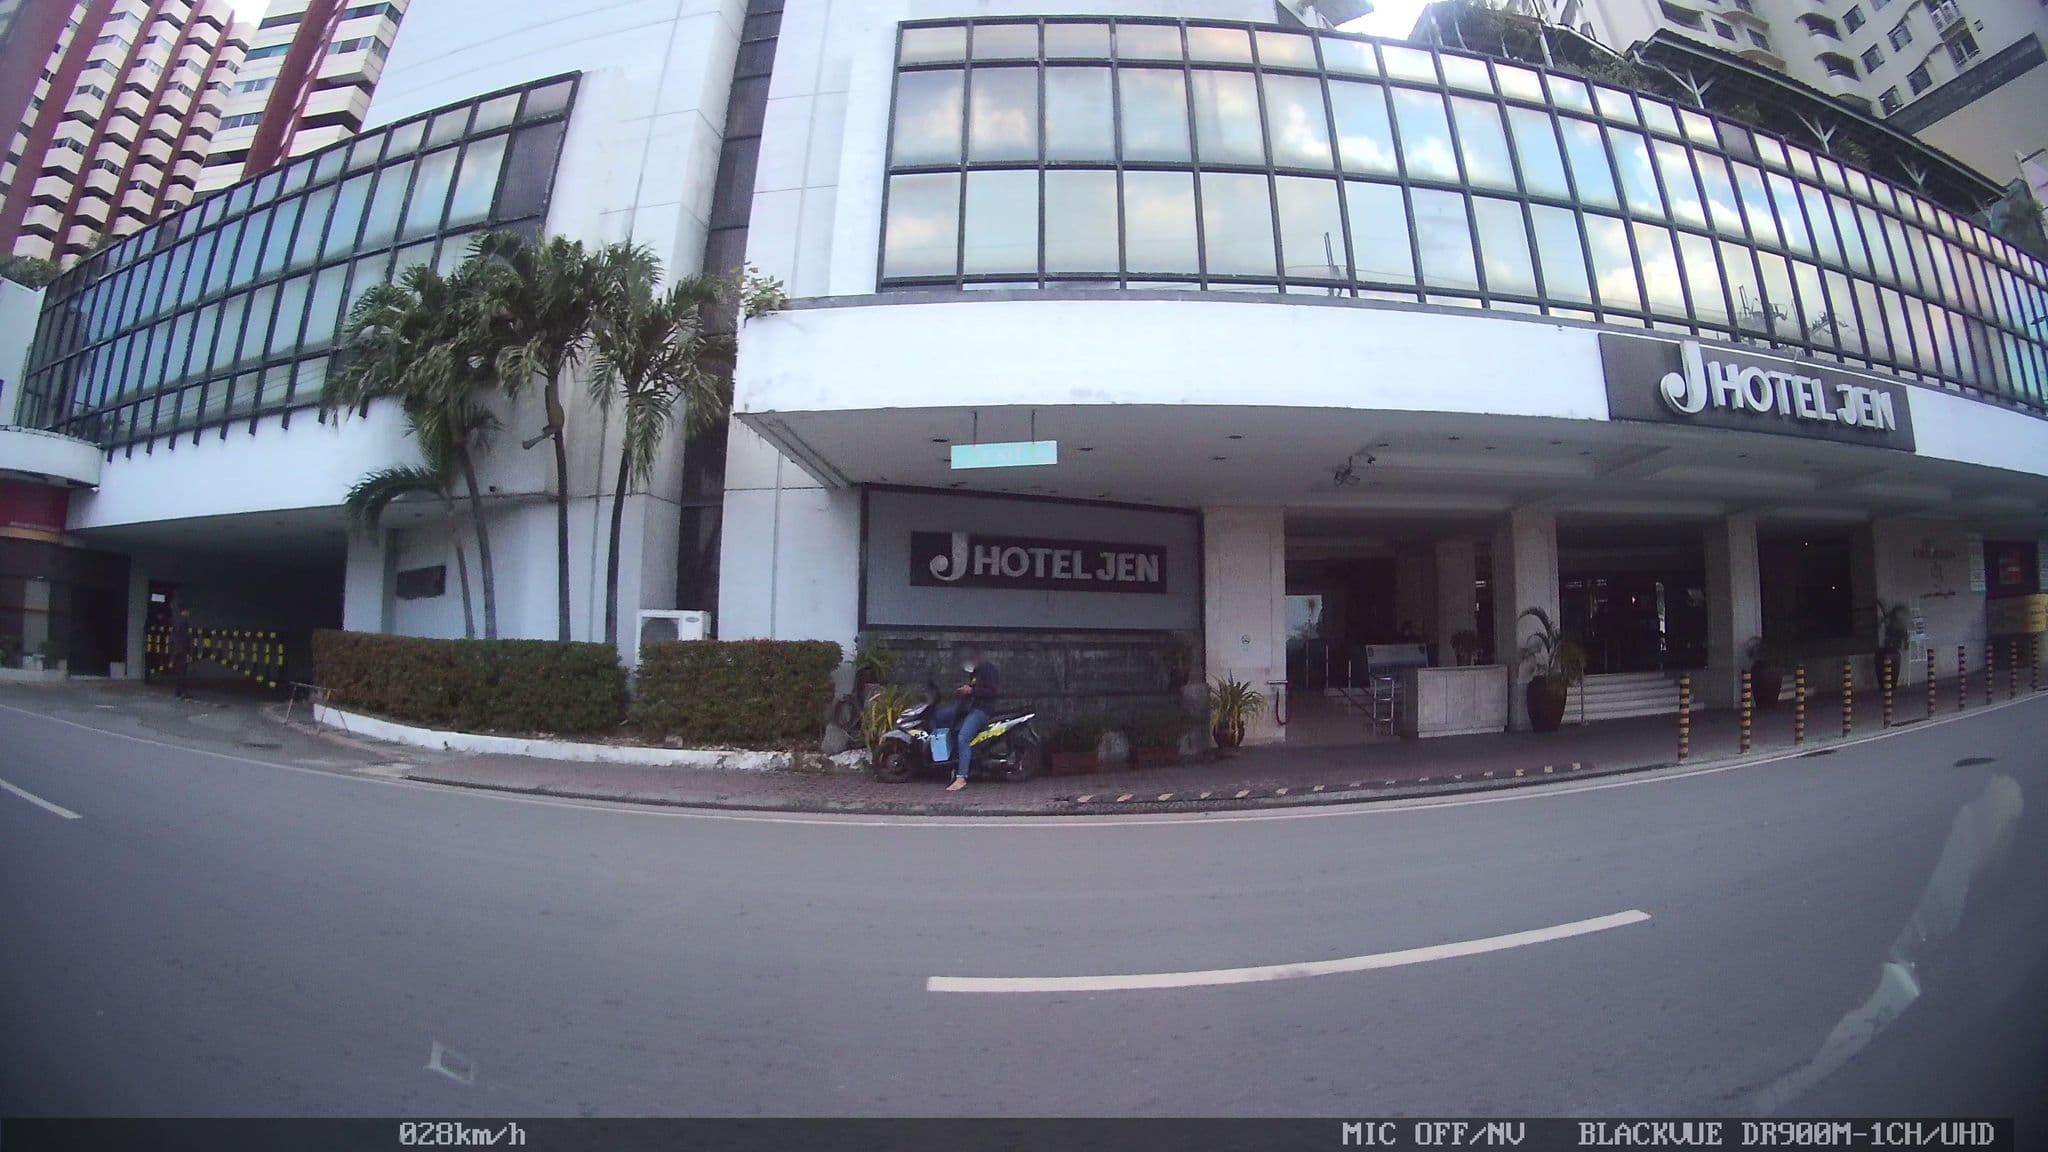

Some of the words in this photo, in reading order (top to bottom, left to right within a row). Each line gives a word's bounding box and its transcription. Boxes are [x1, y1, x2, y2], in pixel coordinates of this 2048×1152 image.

[1707, 360, 1837, 421] HOTEL
[1835, 383, 1896, 431] JEN
[974, 545, 1092, 579] HOTEL
[1096, 552, 1159, 582] JEN
